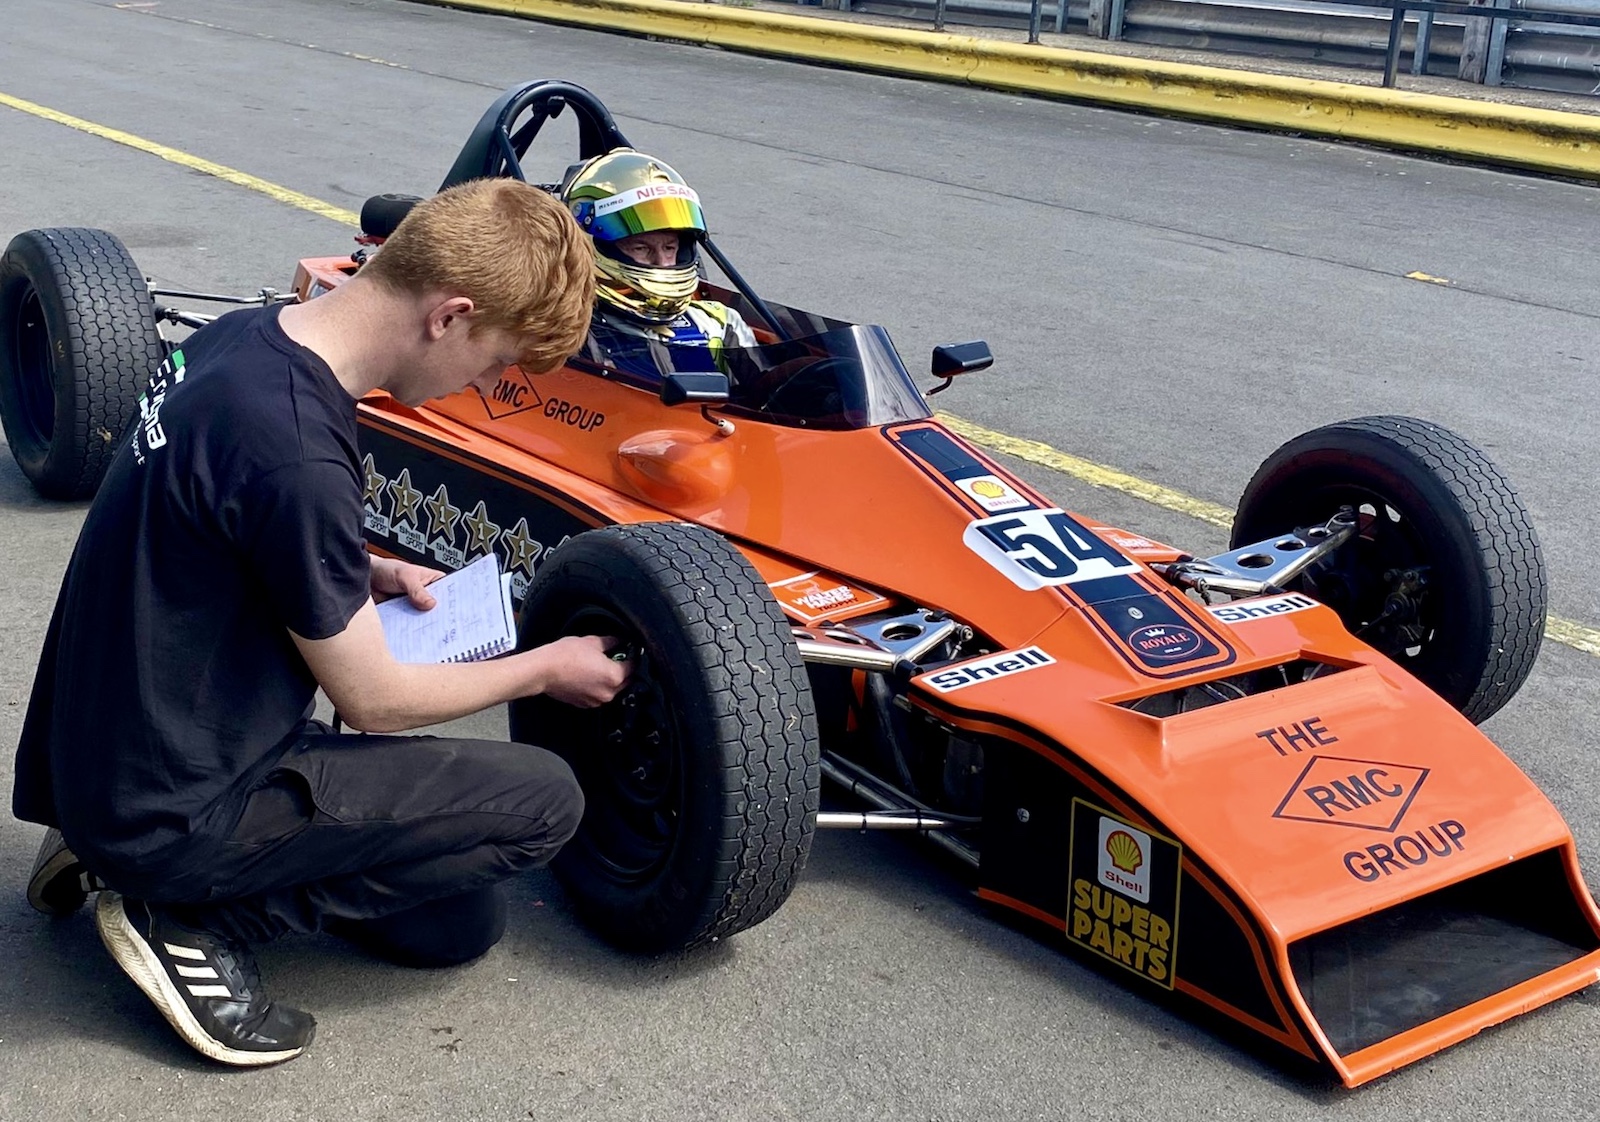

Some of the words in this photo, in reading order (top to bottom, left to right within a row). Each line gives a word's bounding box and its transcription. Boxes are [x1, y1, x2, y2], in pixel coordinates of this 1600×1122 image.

[636, 185, 695, 200] NISSAN
[543, 397, 605, 432] GROUP
[367, 474, 373, 490] 1
[403, 489, 409, 507] 1
[988, 498, 1021, 508] Shell
[440, 505, 446, 524] 1
[369, 520, 387, 533] SPORT
[399, 524, 421, 540] Shell
[478, 523, 485, 541] 1
[405, 536, 423, 550] SPORT
[436, 542, 459, 557] Shell
[519, 540, 526, 558] 1
[975, 512, 1135, 578] 54
[442, 553, 461, 568] SPORT
[791, 585, 851, 606] WALTER
[806, 593, 856, 609] HAYES
[816, 597, 859, 612] TROPHY
[1212, 596, 1314, 622] Shell
[1139, 632, 1191, 650] ROYALE
[929, 650, 1051, 689] Shell
[1255, 716, 1339, 756] THE
[1303, 768, 1403, 817] RMC
[1343, 819, 1466, 882] GROUP
[1105, 870, 1143, 894] Shell
[1073, 878, 1171, 951] SUPER
[1073, 908, 1168, 980] PARTS
